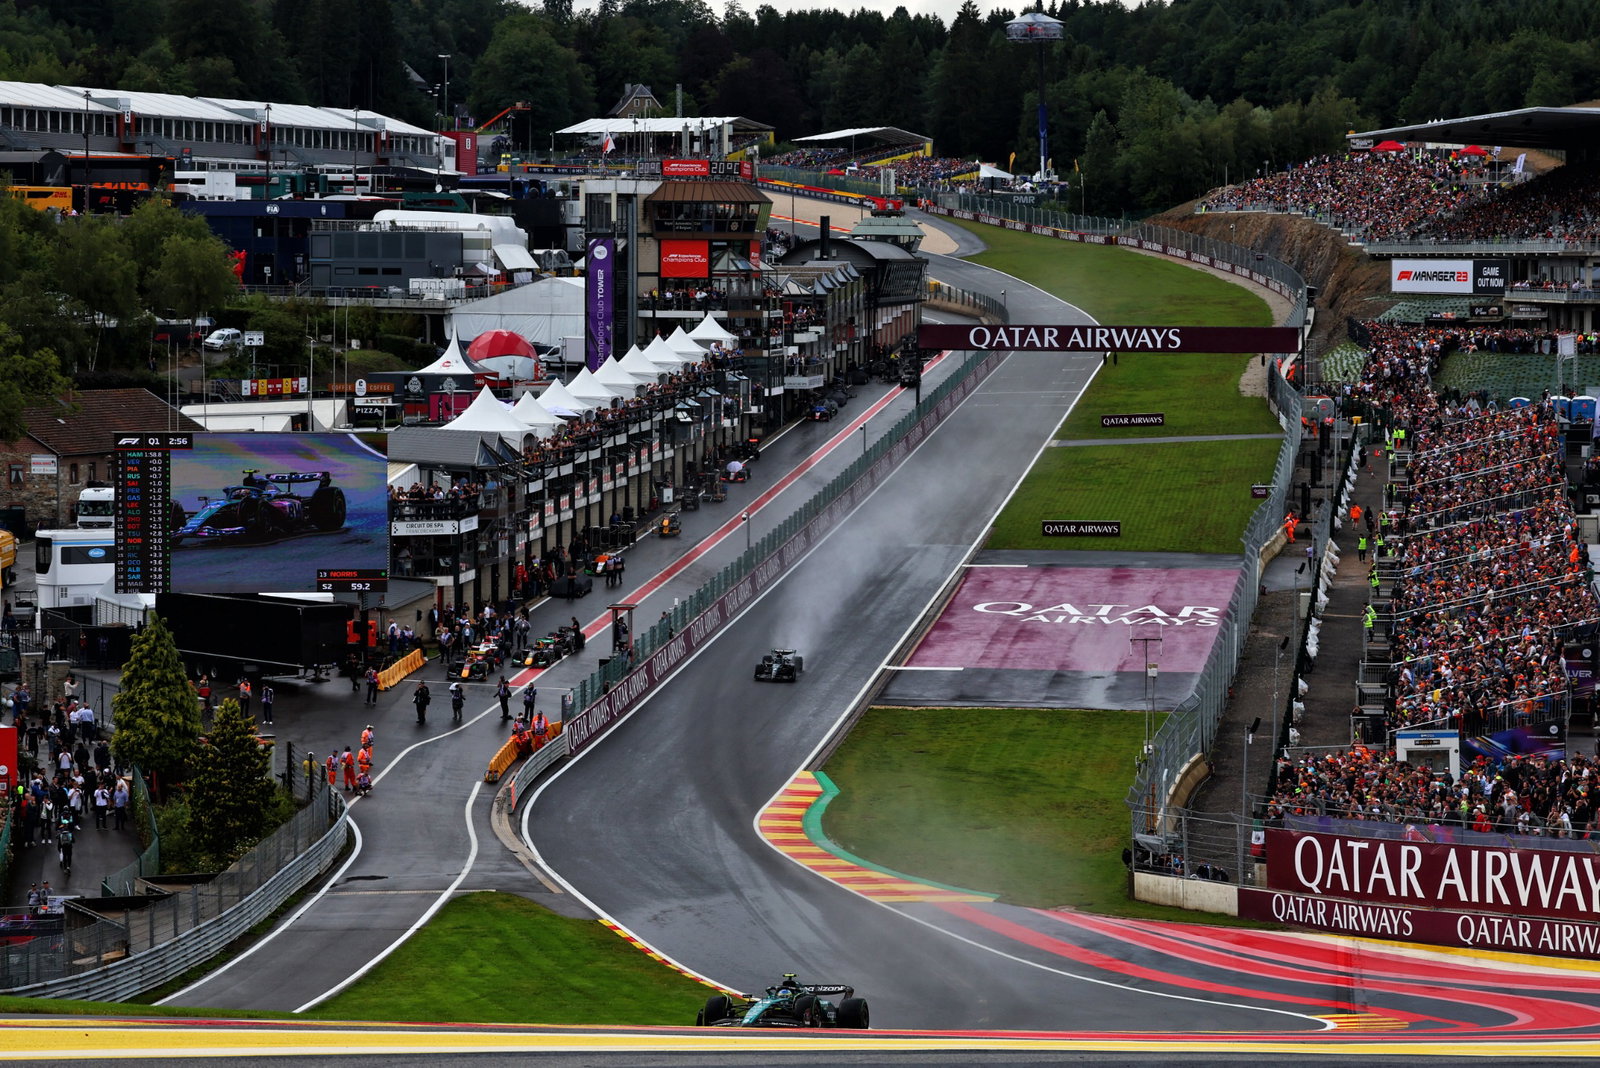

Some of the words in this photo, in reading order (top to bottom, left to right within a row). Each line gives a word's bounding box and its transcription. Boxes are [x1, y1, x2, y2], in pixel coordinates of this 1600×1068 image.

[1412, 271, 1455, 281] MANAGER
[1456, 272, 1469, 282] 23
[1478, 278, 1489, 287] OUT
[1490, 278, 1504, 287] NOW
[1482, 267, 1500, 276] GAME
[969, 326, 1060, 349] QATAR
[1067, 328, 1181, 348] AIRWAYS
[1044, 525, 1076, 534] QATAR
[1078, 525, 1118, 533] AIRWAYS
[690, 617, 705, 647] QATAR
[704, 604, 720, 634] AIRWAYS
[973, 602, 1220, 618] QATAR
[1020, 615, 1220, 626] AIRWAYS
[652, 651, 668, 680] QATAR
[668, 633, 686, 664] AIRWAYS
[611, 684, 629, 716] QATAR
[629, 665, 649, 702] AIRWAYS
[568, 715, 589, 750] QATAR
[588, 698, 611, 734] AIRWAYS
[1294, 836, 1425, 899] QATAR
[1272, 894, 1327, 926] QATAR
[1332, 903, 1413, 936] AIRWAYS
[1457, 915, 1532, 948] QATAR
[1539, 923, 1600, 954] AIRW
